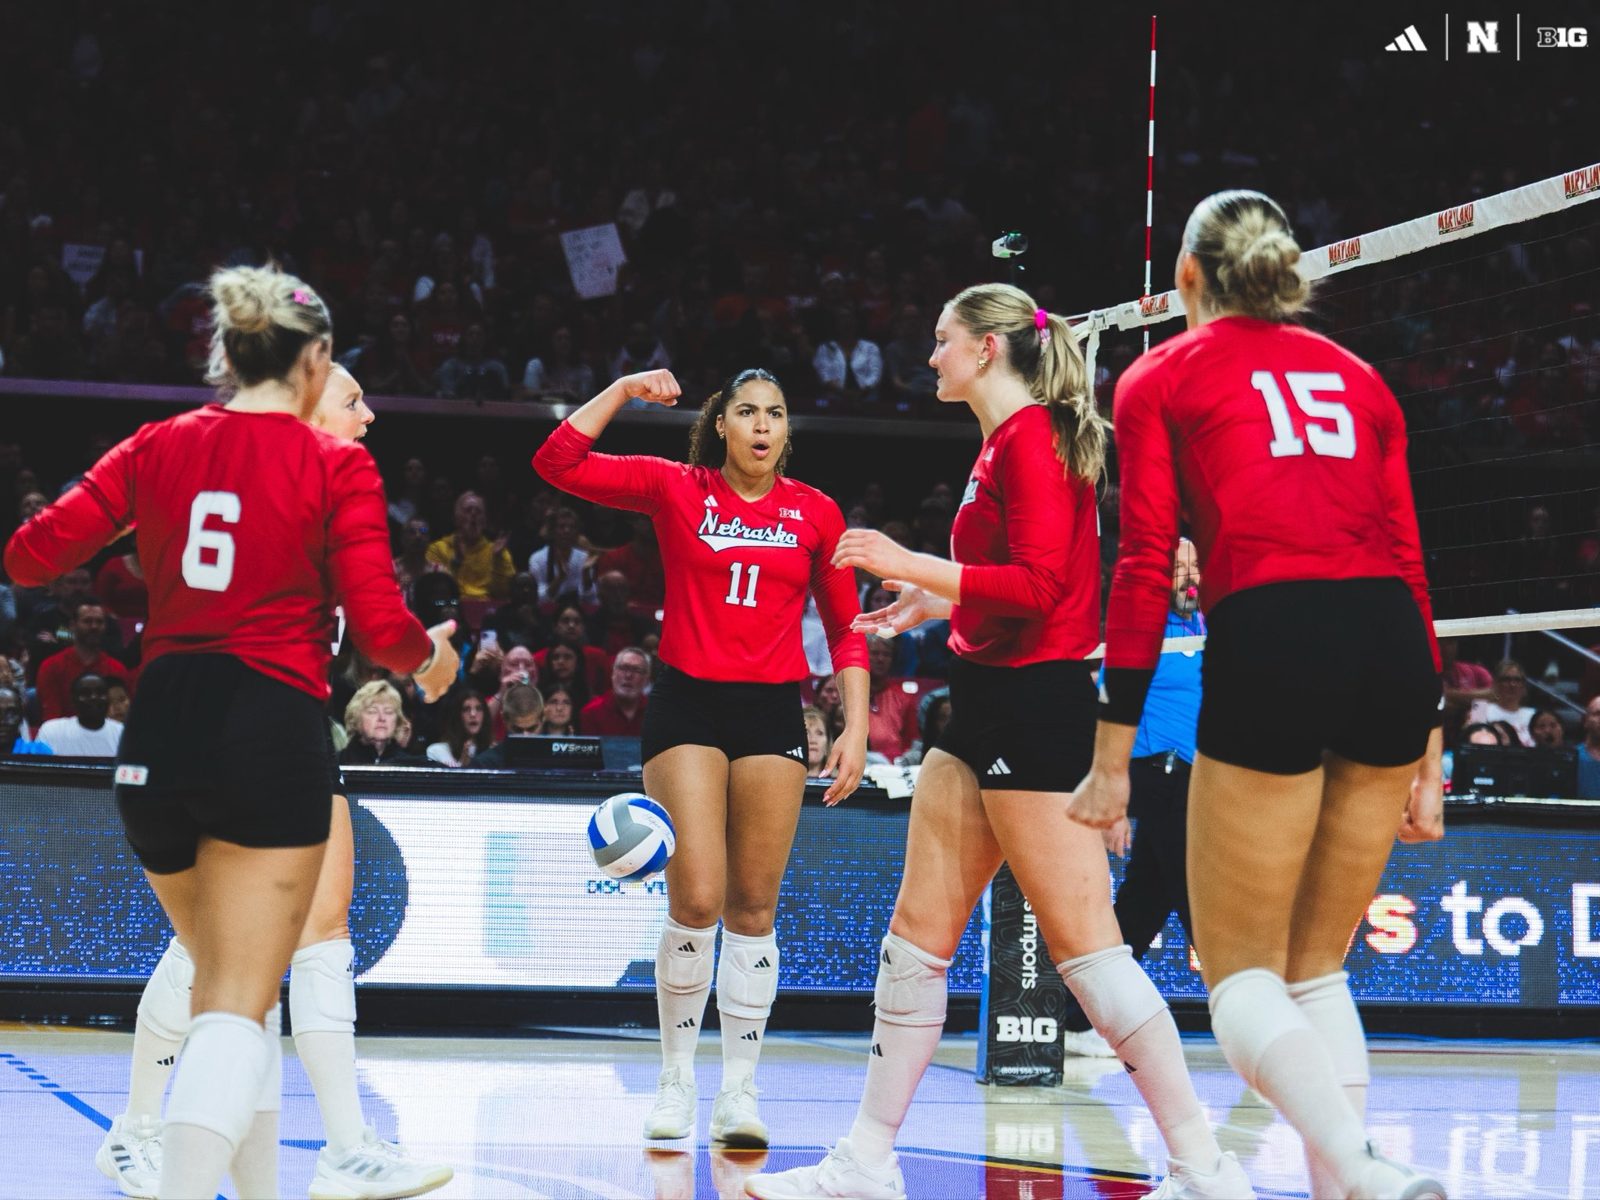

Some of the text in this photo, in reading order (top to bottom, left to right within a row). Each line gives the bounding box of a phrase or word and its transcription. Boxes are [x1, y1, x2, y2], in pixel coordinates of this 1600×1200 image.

[1564, 165, 1600, 193] MARYLAN
[1250, 370, 1357, 459] 15
[181, 490, 242, 592] 6
[698, 507, 799, 545] Nebraska
[725, 561, 761, 608] 11
[1439, 880, 1545, 956] to
